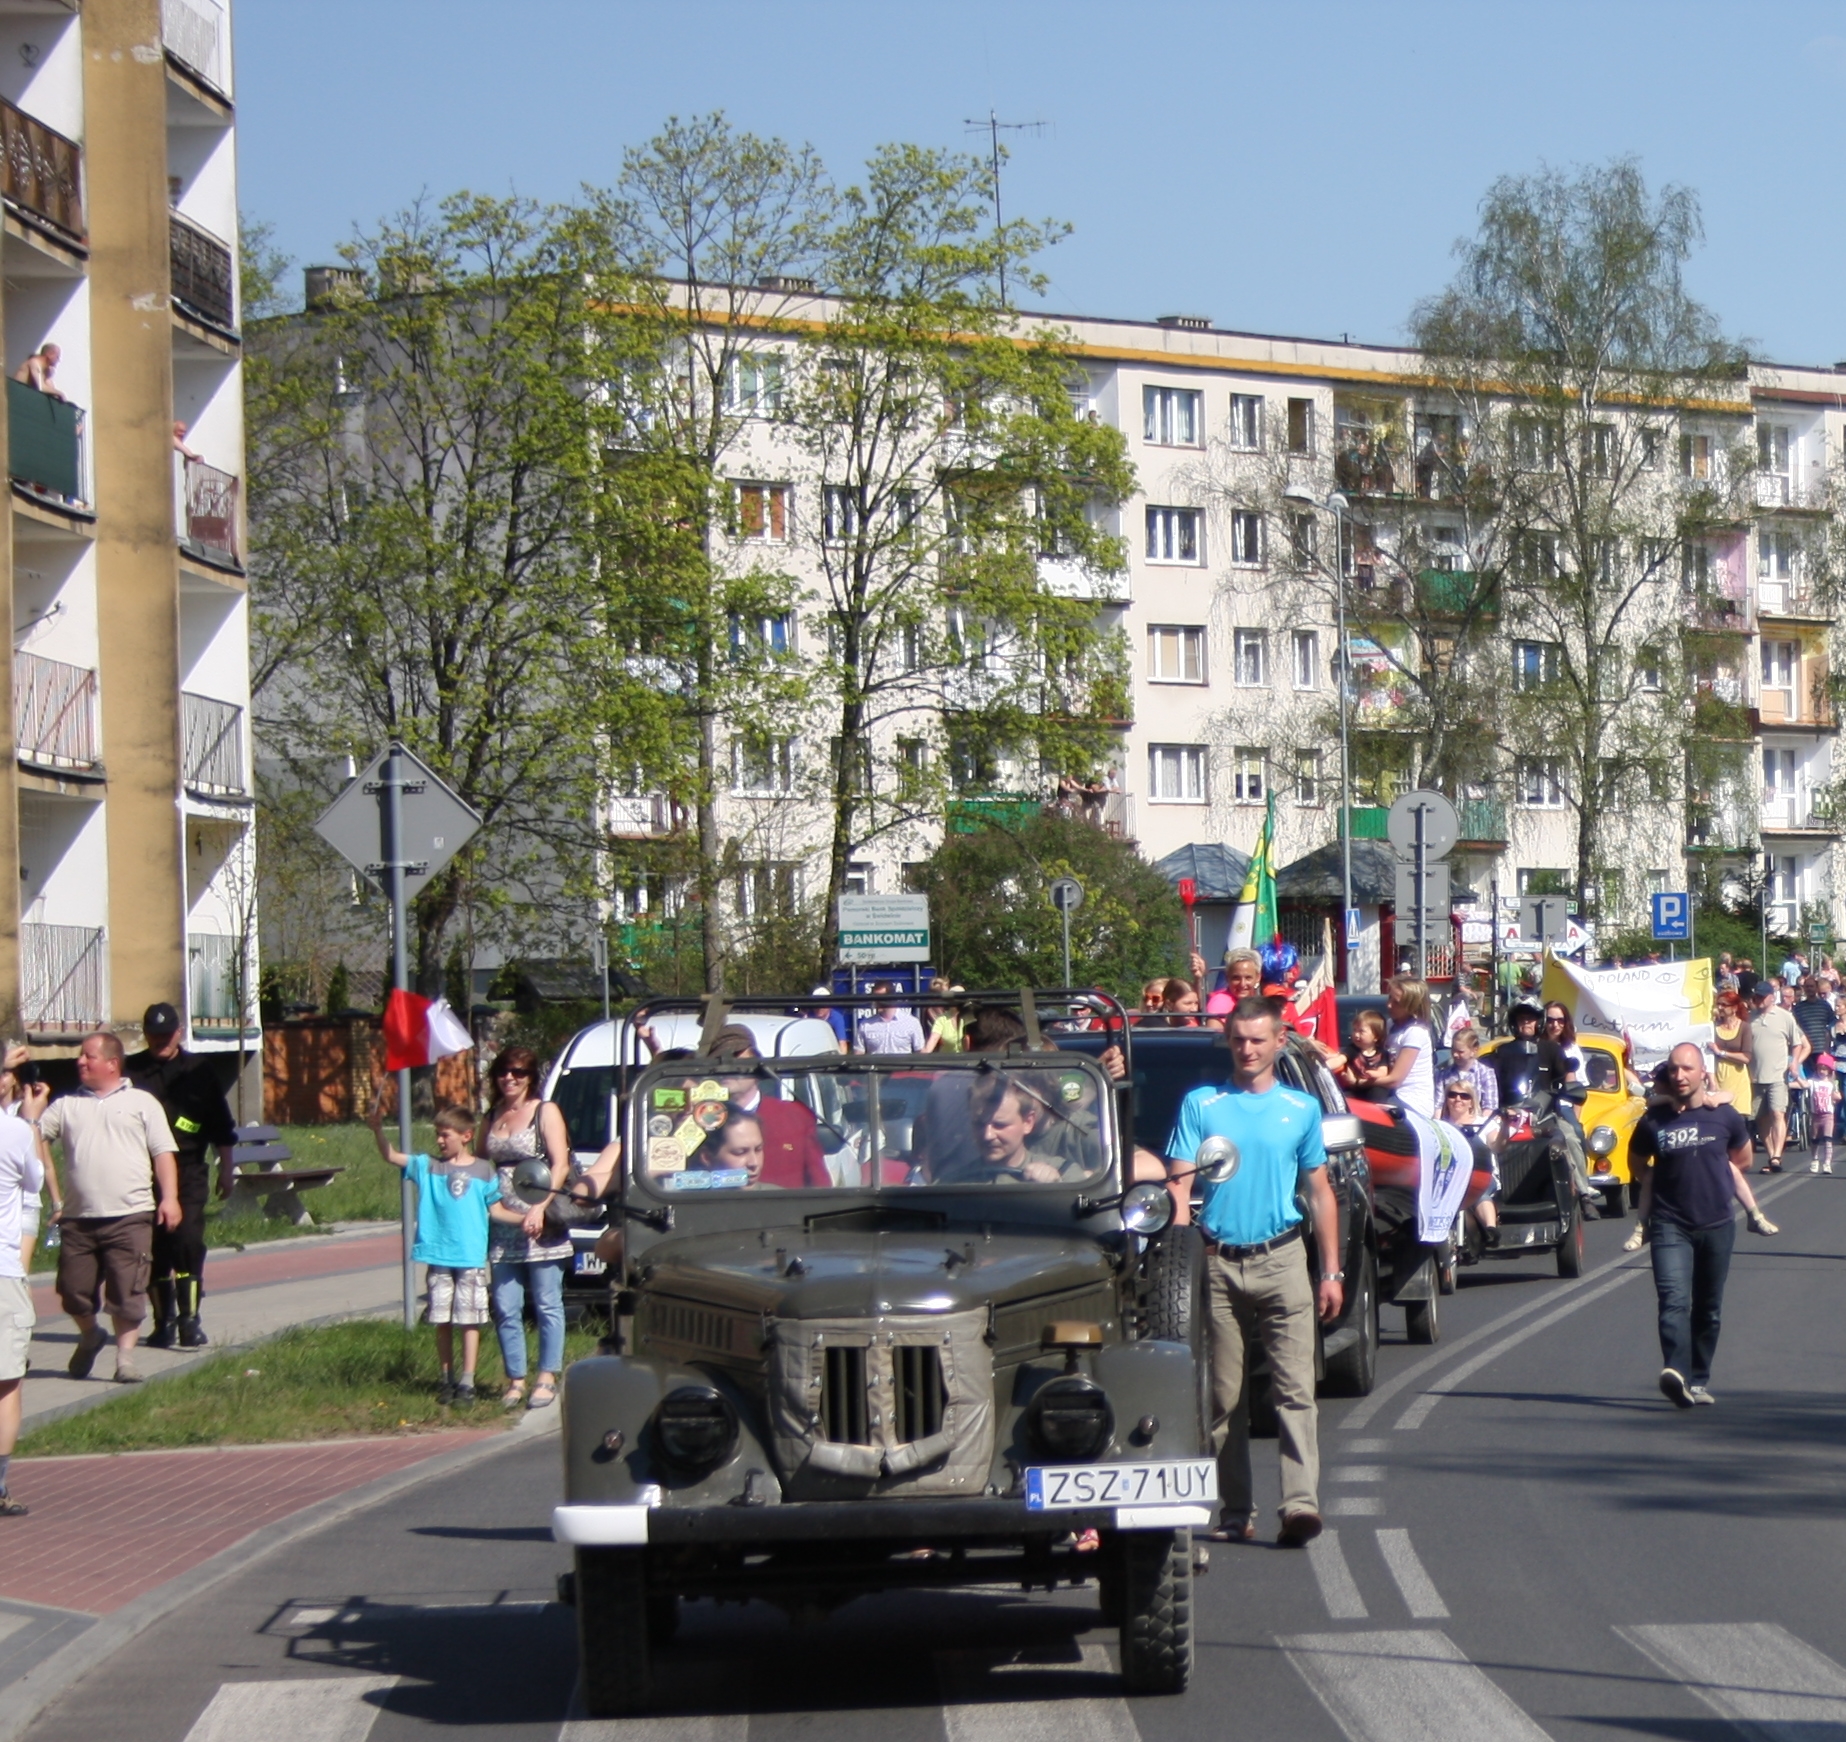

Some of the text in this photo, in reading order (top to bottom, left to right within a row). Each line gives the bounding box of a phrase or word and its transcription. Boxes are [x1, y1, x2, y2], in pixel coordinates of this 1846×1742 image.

[1660, 896, 1680, 926] P
[843, 933, 924, 945] BANKOMAT
[1667, 1127, 1698, 1146] 302
[1049, 1469, 1121, 1504] ZSZ
[1132, 1465, 1210, 1500] 71UY
